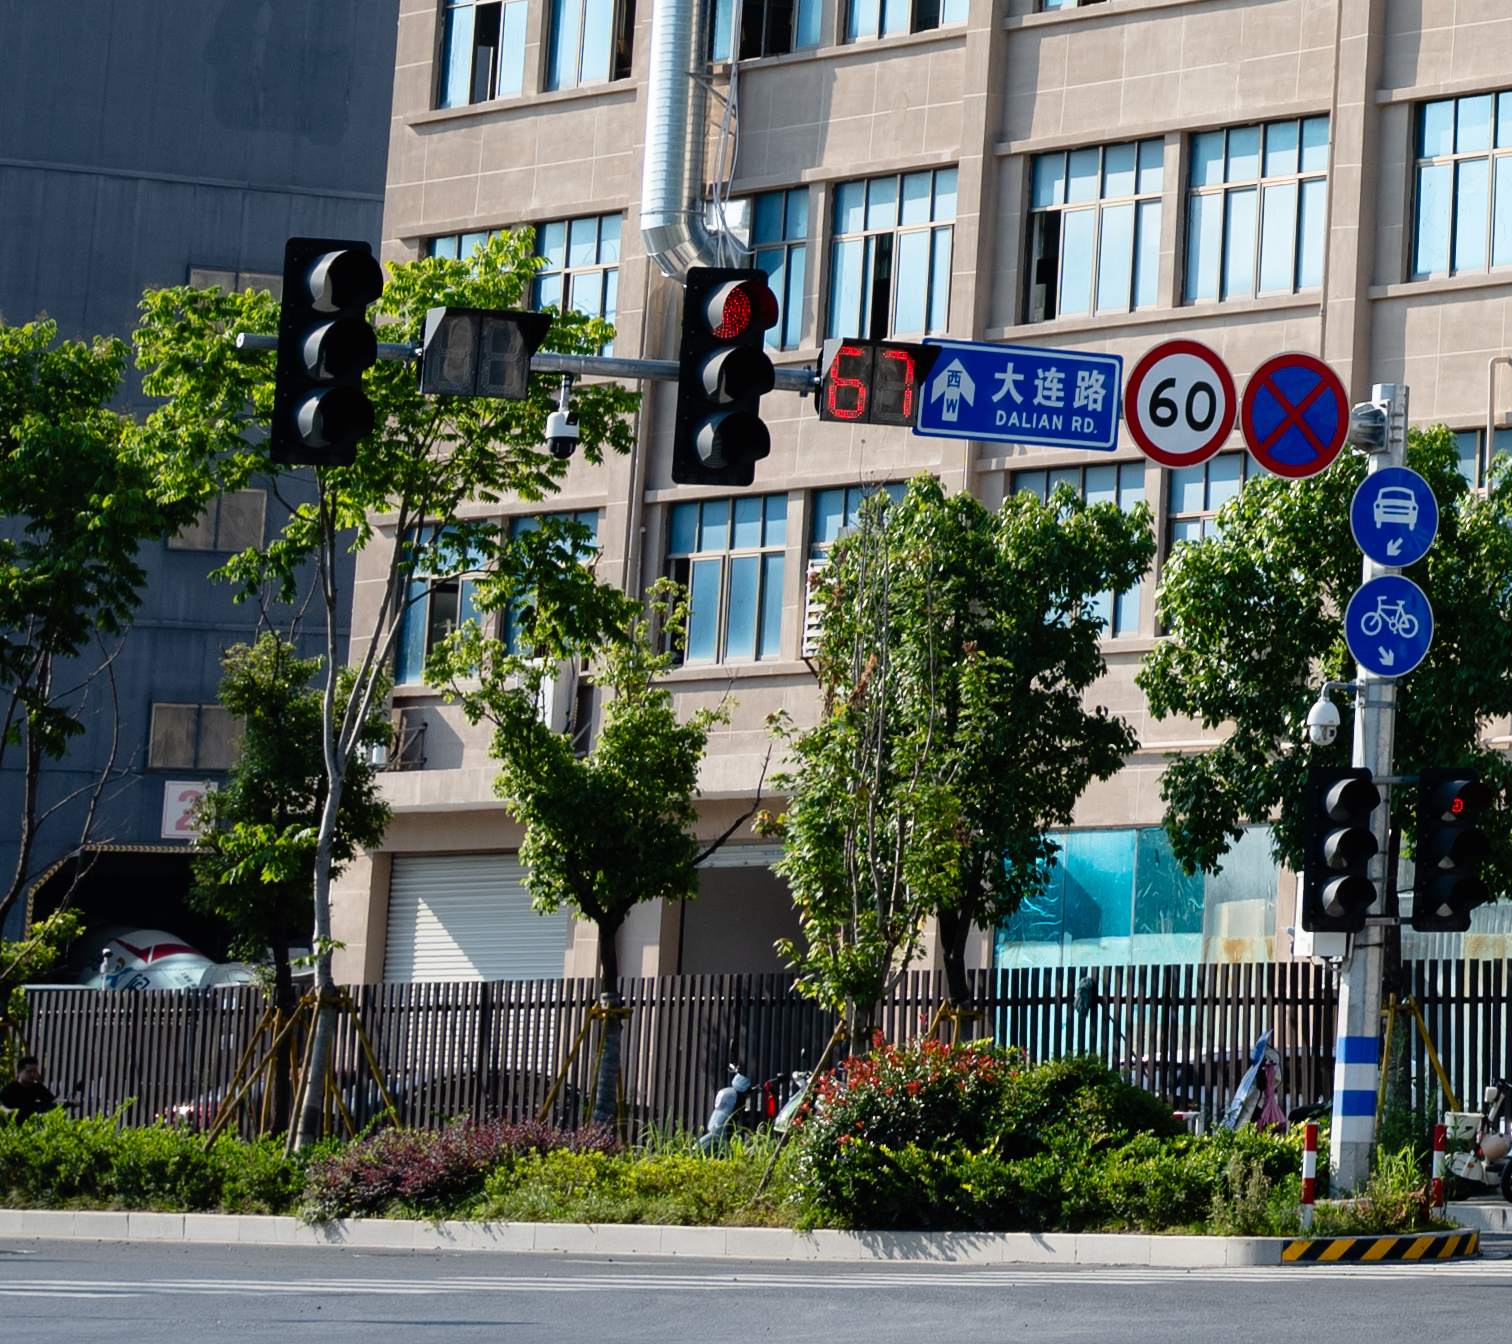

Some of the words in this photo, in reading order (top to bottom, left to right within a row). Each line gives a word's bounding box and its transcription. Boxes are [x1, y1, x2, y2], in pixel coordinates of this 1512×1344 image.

[828, 345, 915, 419] 67
[947, 369, 962, 388] 西
[992, 361, 1108, 413] 大连路
[946, 398, 958, 413] W
[995, 409, 1064, 431] DALIAN
[1071, 416, 1099, 435] RD.
[1149, 377, 1217, 432] 60
